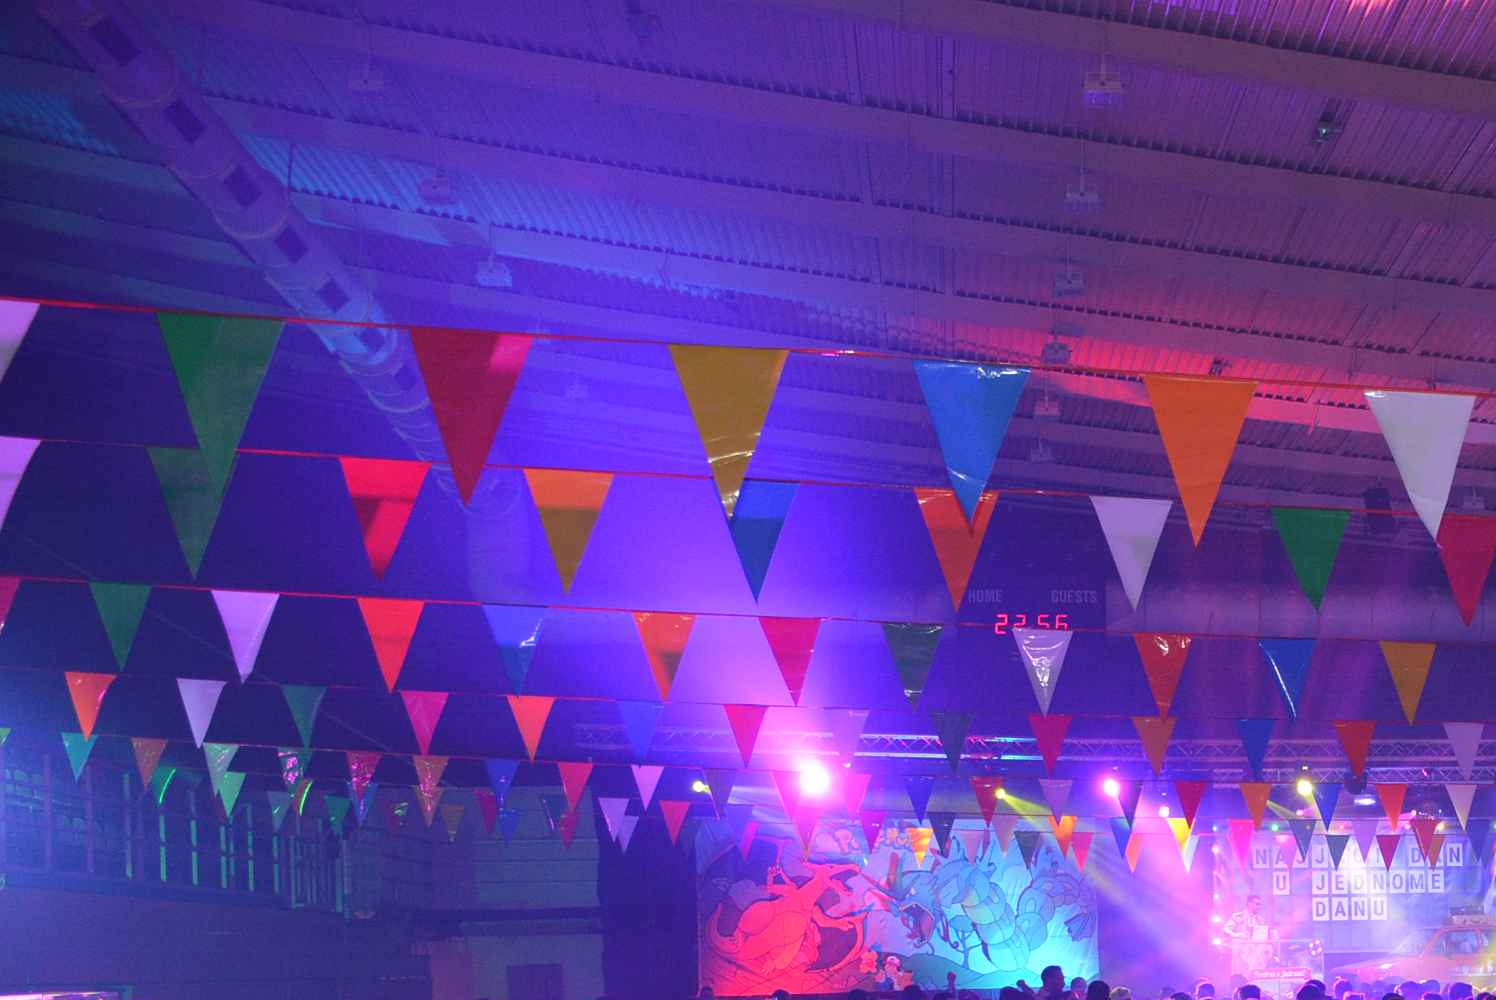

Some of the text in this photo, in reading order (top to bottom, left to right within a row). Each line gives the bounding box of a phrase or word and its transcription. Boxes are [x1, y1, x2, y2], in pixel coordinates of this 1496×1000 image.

[968, 589, 1097, 603] HOME GUESTS
[1411, 848, 1461, 863] DN
[1275, 874, 1441, 891] U JEDNOME
[1315, 902, 1384, 918] DANU
